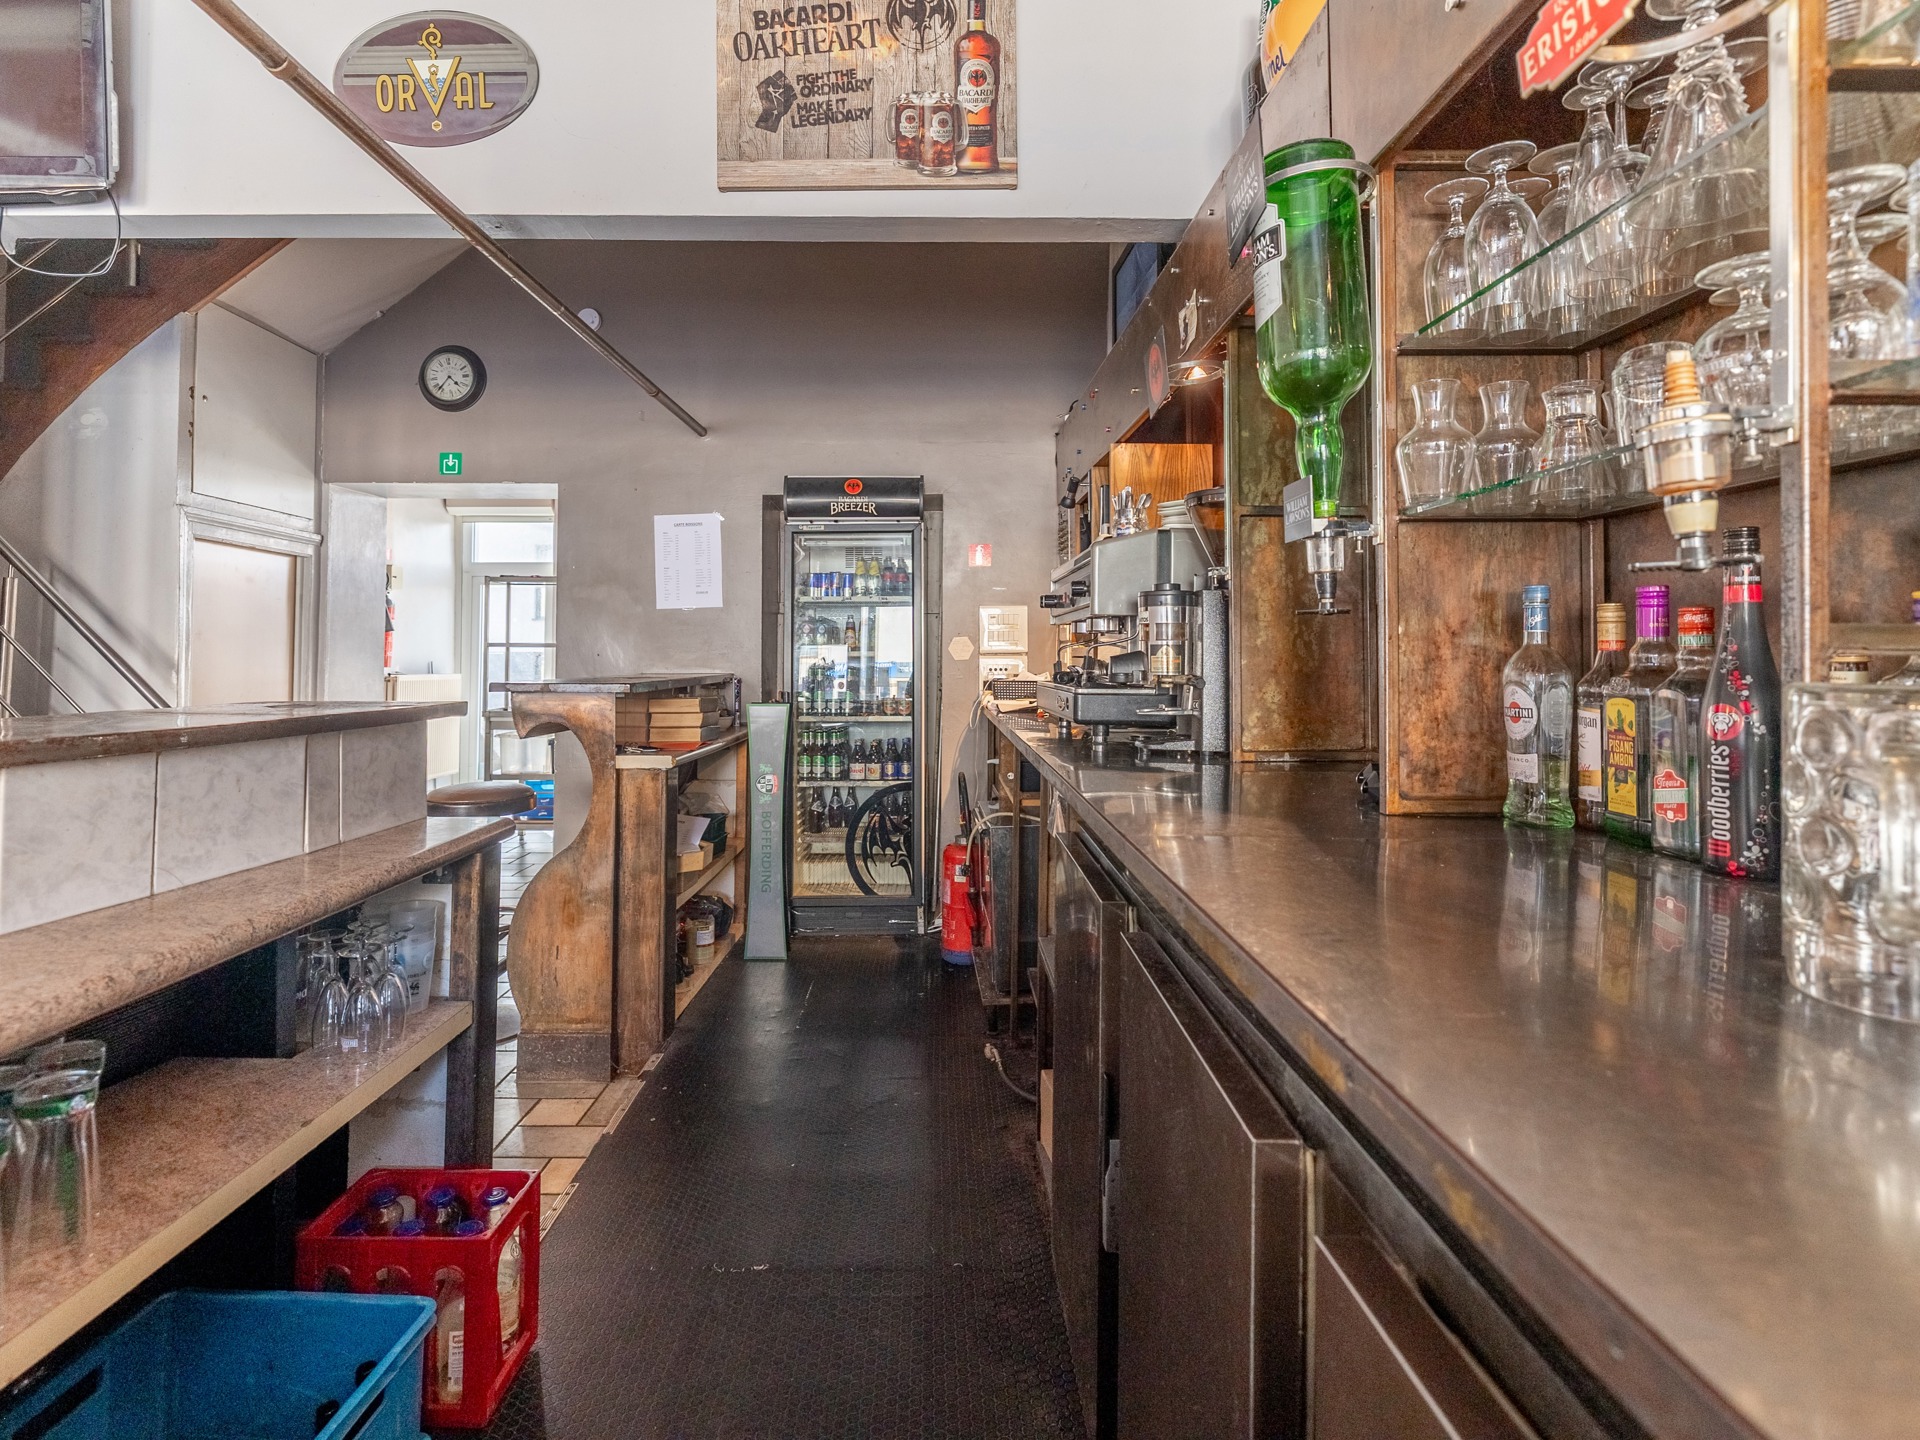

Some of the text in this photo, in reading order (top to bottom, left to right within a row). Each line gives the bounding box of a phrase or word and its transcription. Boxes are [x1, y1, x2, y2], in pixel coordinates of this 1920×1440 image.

[753, 1, 854, 30] BACARDI
[733, 18, 880, 62] OAKHEART
[796, 68, 857, 86] FIGHT THE
[375, 56, 496, 118] ORVAL
[800, 77, 874, 98] ORDINARY
[959, 89, 994, 98] BACARDI
[796, 98, 847, 115] MAKE IT
[790, 107, 873, 129] LEGENDARY
[1230, 161, 1256, 215] WILLIAM
[830, 502, 878, 516] BREEZER
[1286, 495, 1308, 512] WILLIAM
[1609, 739, 1634, 755] PISANG
[1609, 752, 1634, 768] AMBON
[1656, 777, 1681, 789] Tequila
[1707, 744, 1731, 857] Woodberries
[761, 811, 772, 893] BOFFERDING
